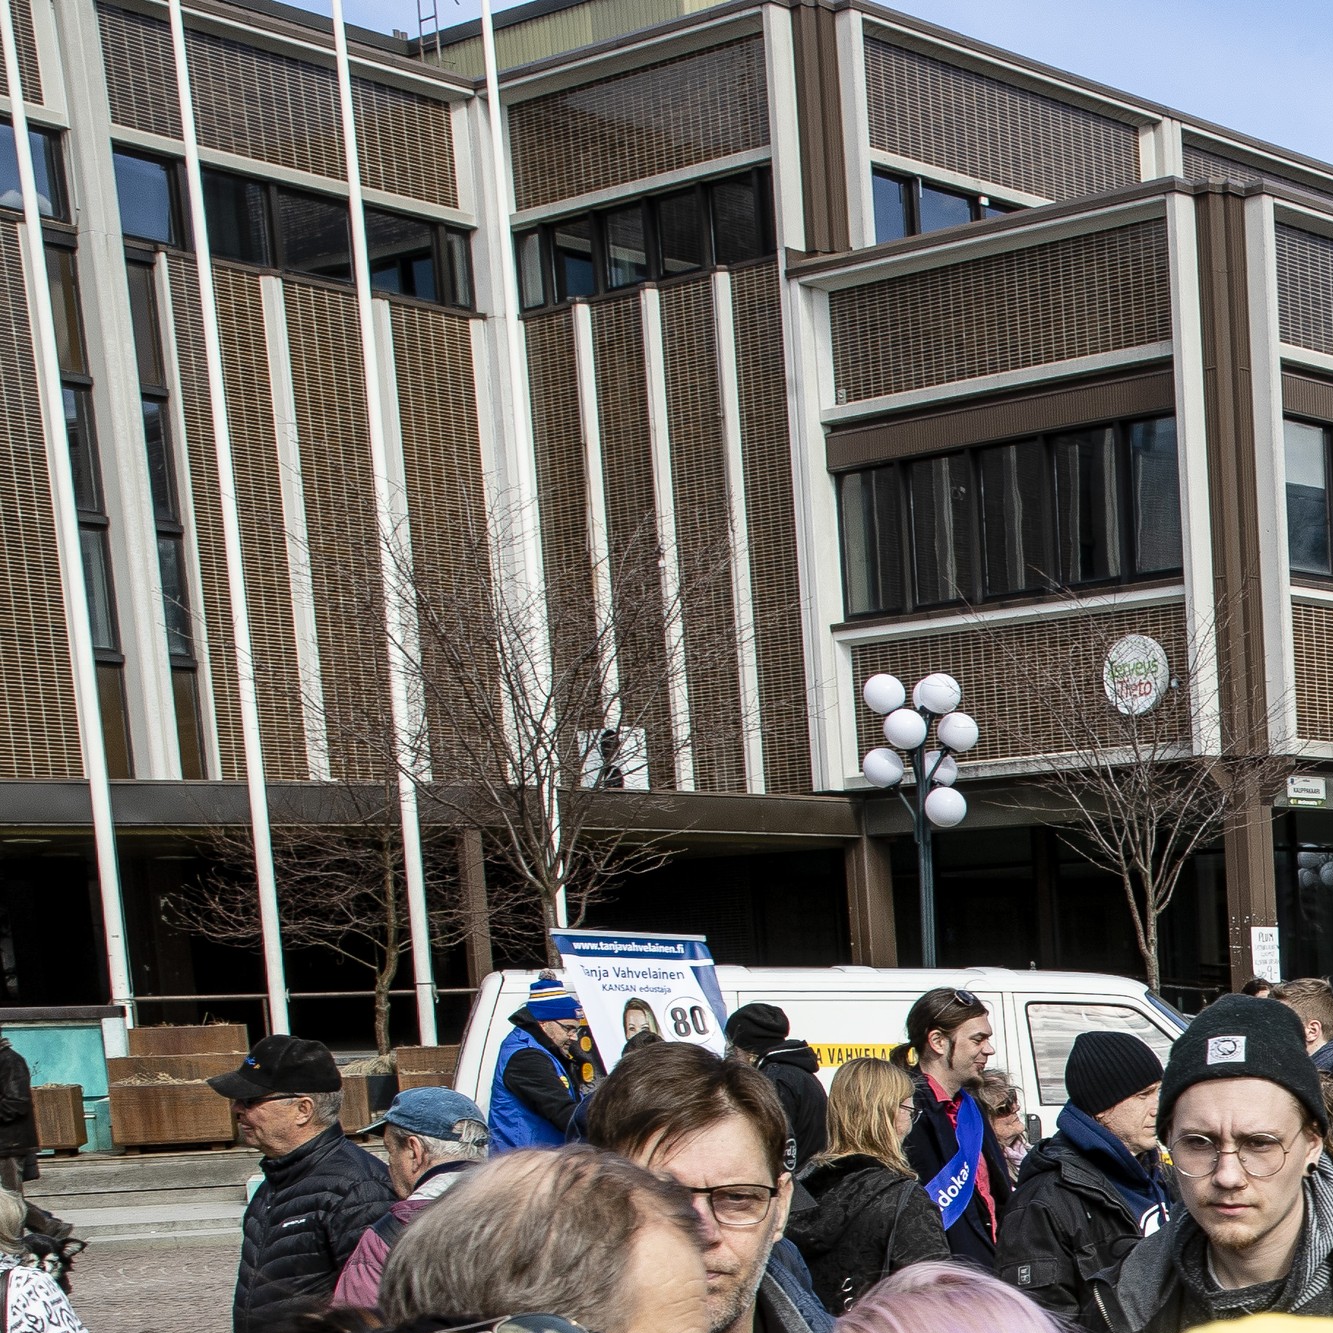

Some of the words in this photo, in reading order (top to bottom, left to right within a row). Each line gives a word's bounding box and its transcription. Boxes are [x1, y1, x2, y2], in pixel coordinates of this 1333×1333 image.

[572, 940, 685, 955] www.tanjavahvelainen.fi
[580, 964, 609, 981] Tanja
[612, 965, 685, 981] Vahvelainen
[601, 983, 637, 993] KANSAN
[639, 984, 672, 995] edustaja
[670, 1005, 710, 1038] 80
[827, 1047, 893, 1065] VAHVELA
[939, 1161, 970, 1212] dokas
